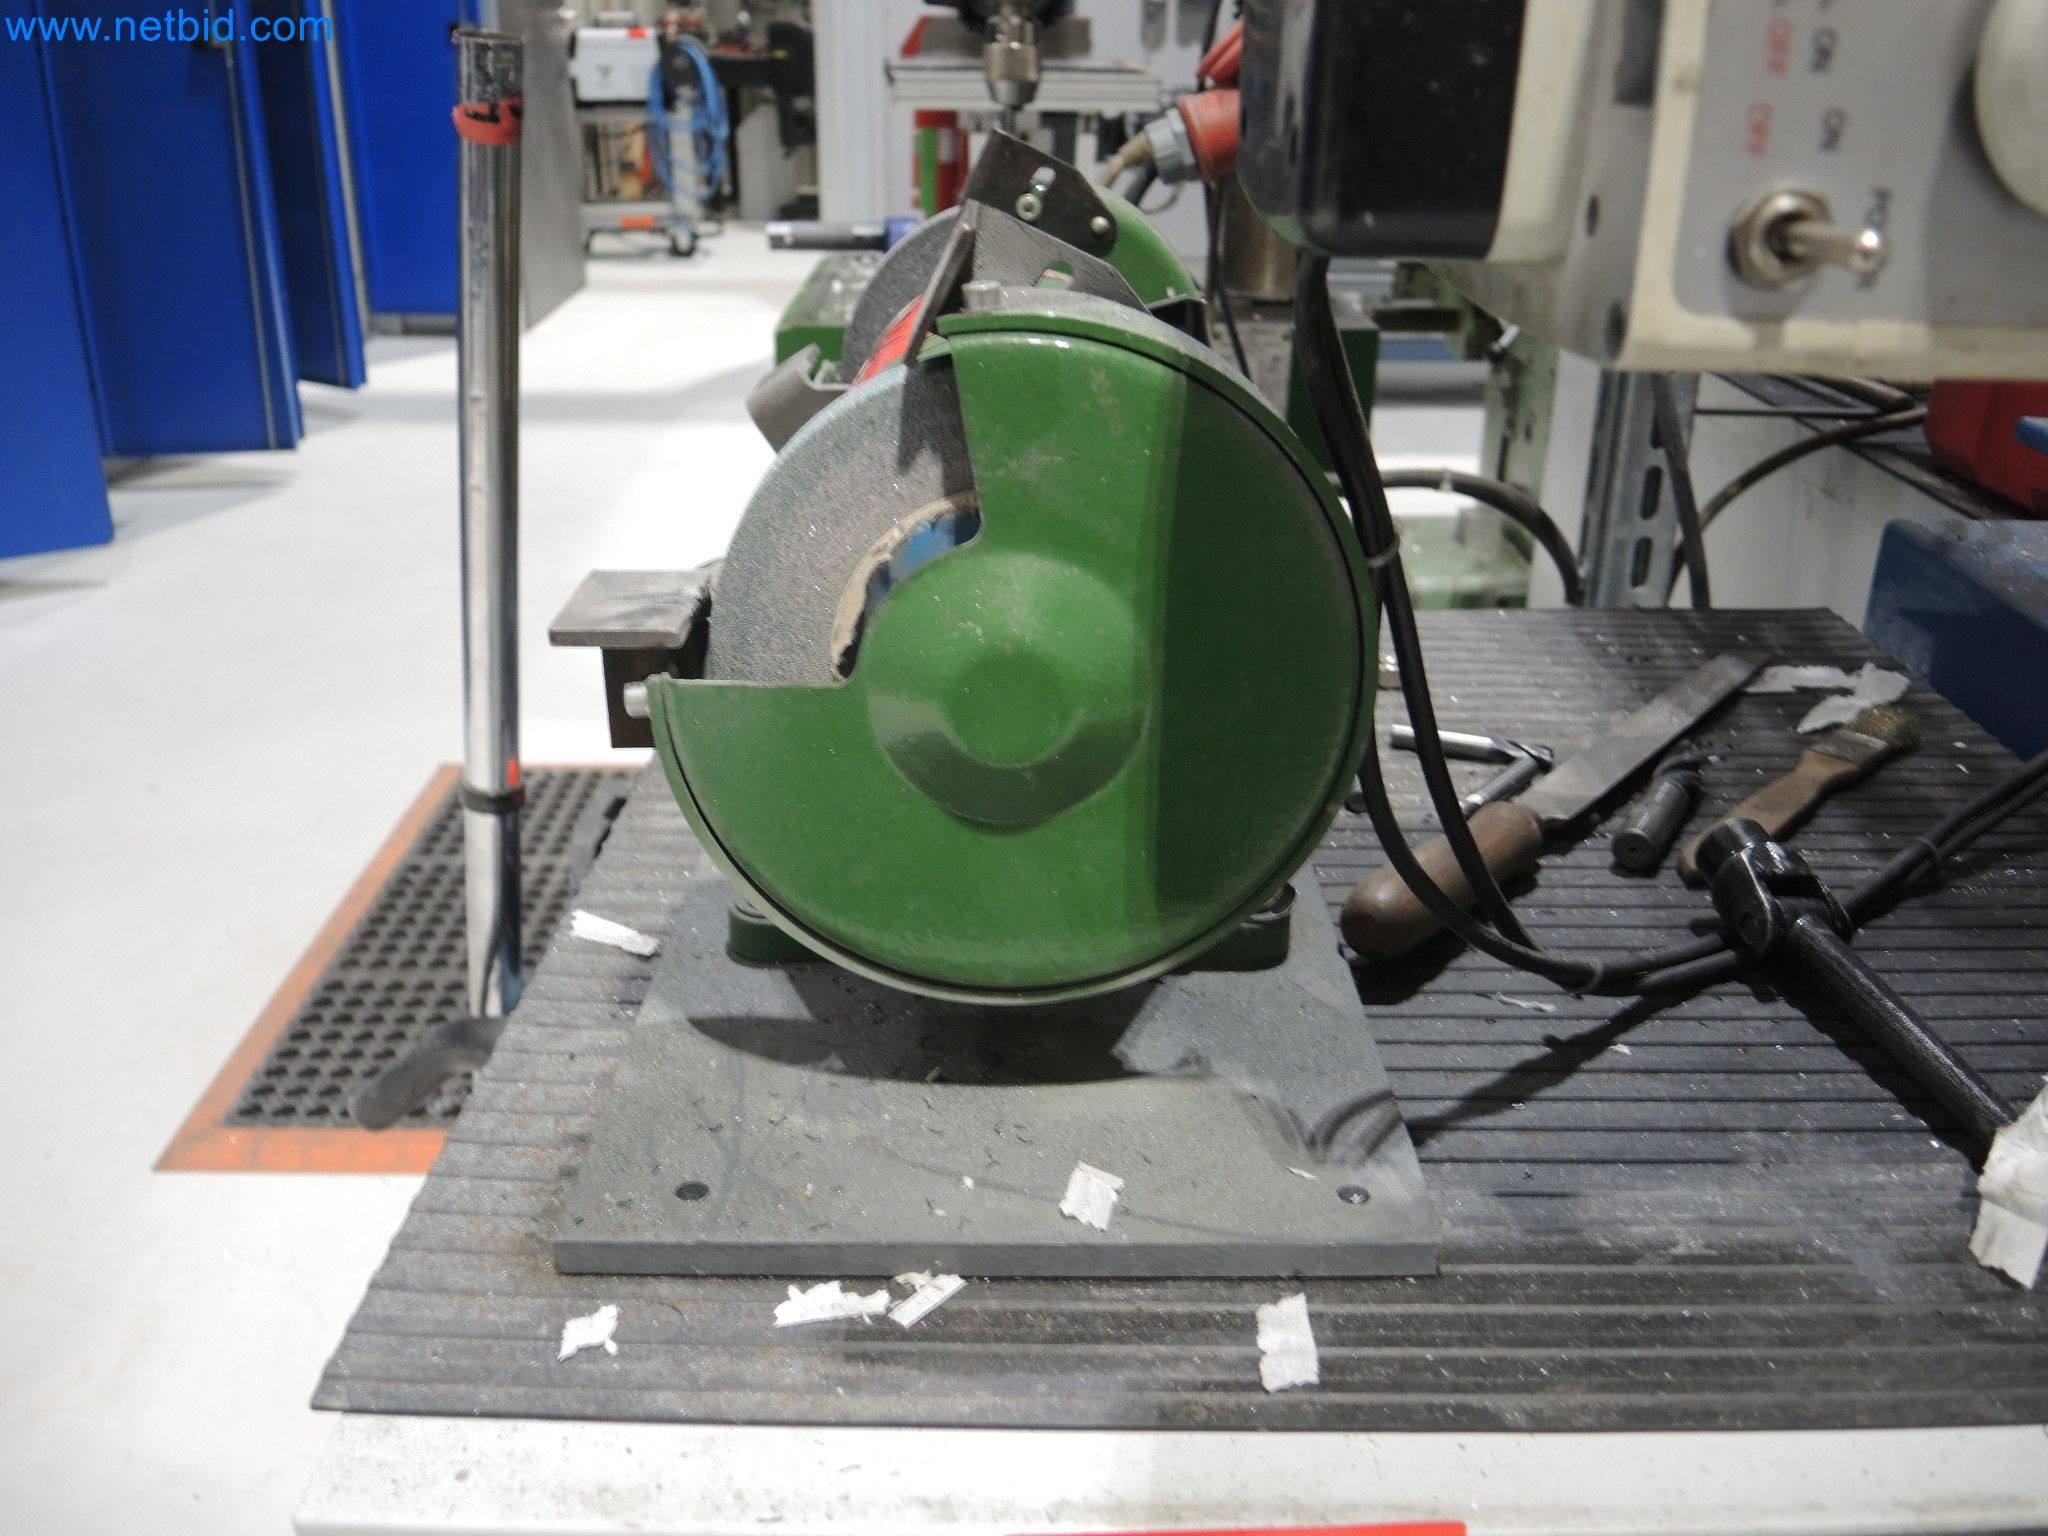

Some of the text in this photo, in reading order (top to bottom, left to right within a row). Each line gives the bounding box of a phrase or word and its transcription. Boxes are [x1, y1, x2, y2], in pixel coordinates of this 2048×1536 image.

[1766, 17, 1795, 76] OFF
[1811, 27, 1839, 74] ON
[1746, 101, 1774, 155] OFF
[1821, 107, 1849, 152] ON
